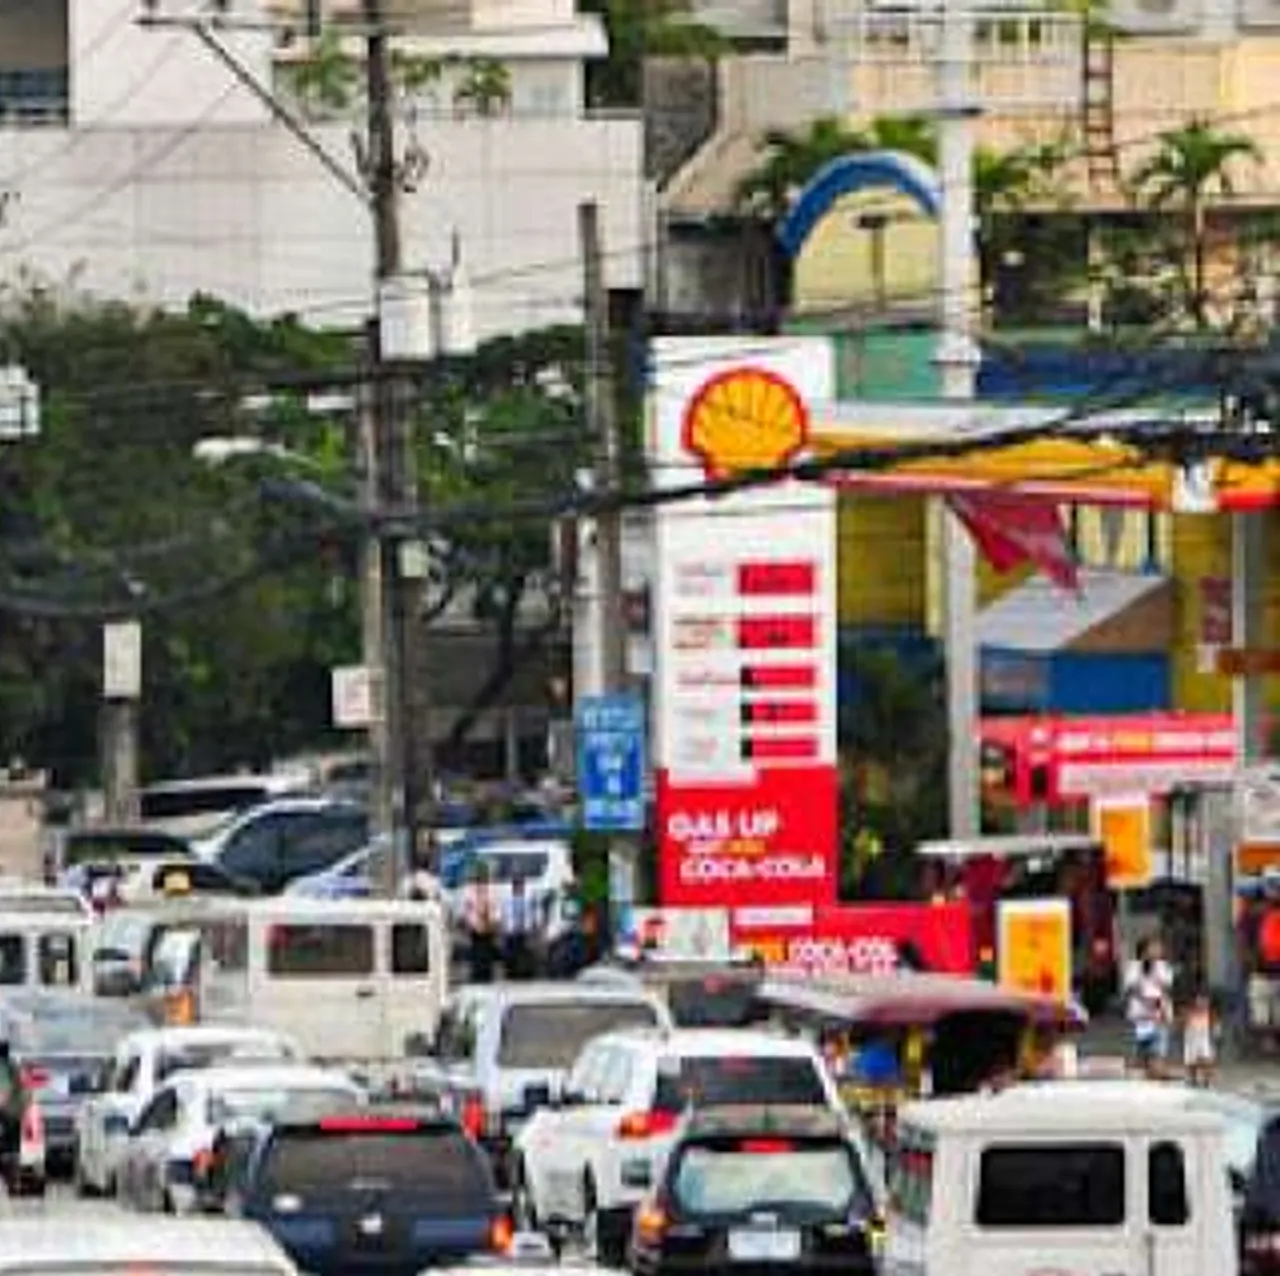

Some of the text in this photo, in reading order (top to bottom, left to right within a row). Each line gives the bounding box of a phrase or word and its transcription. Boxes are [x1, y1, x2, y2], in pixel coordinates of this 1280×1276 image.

[739, 808, 779, 836] UP
[680, 855, 826, 884] COCA-COLA
[789, 936, 899, 962] COCA-COL
